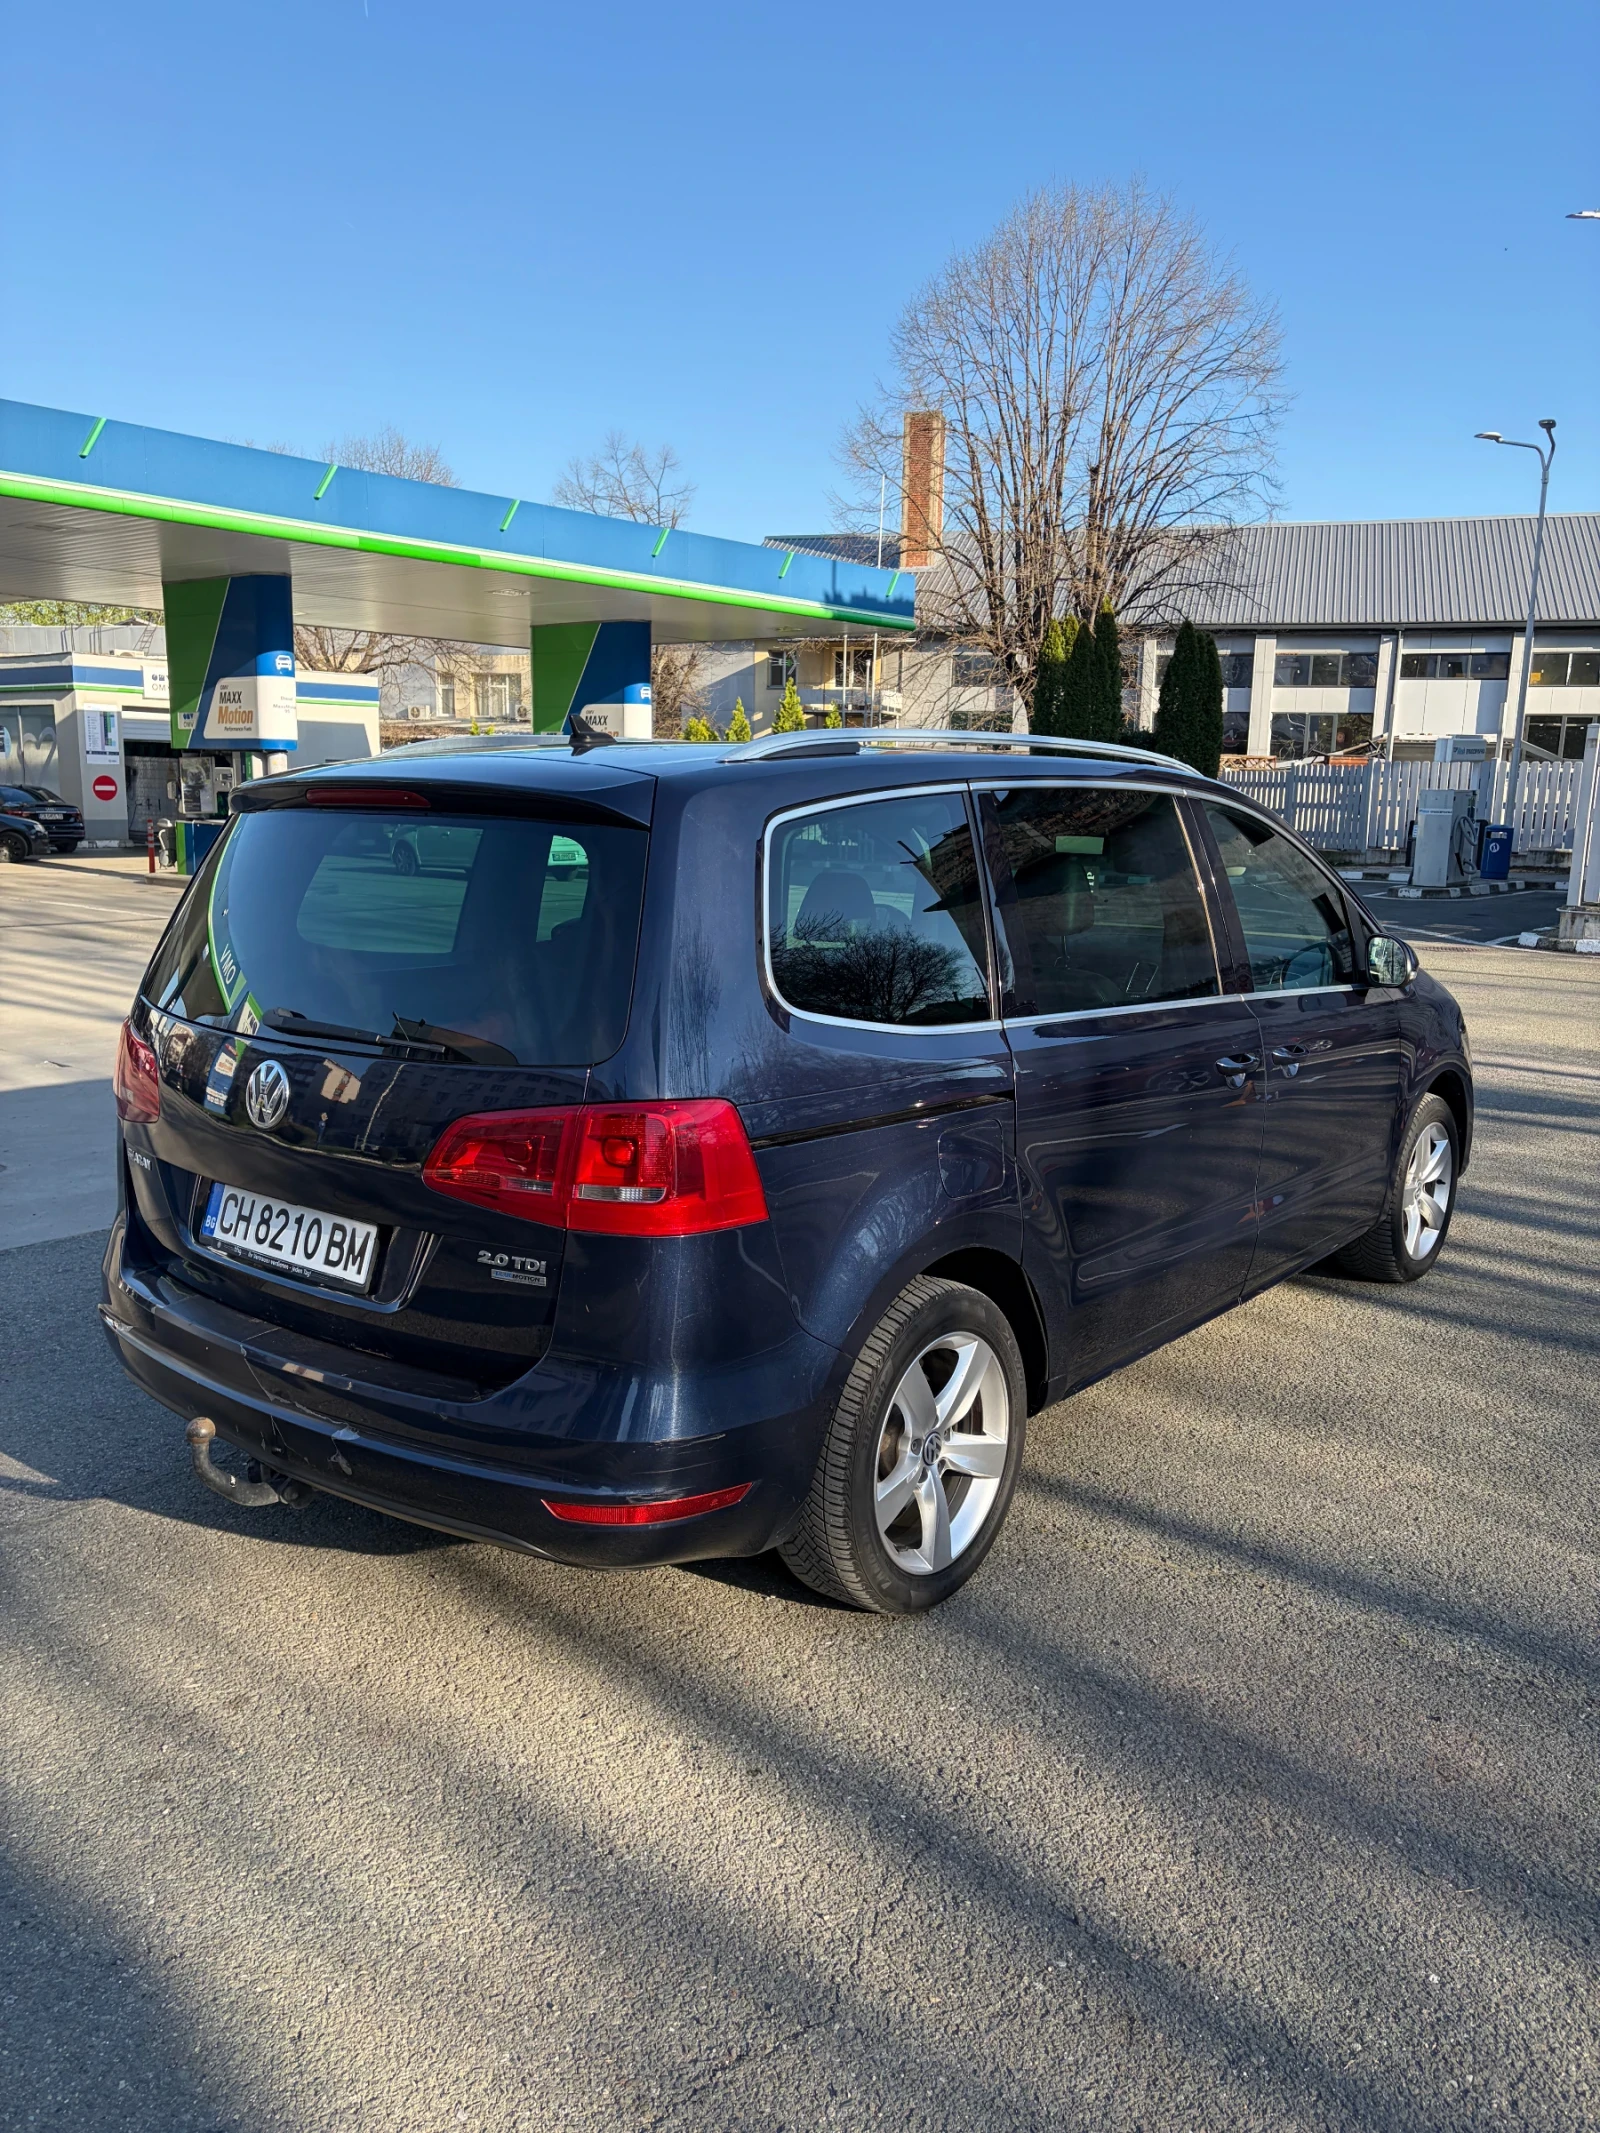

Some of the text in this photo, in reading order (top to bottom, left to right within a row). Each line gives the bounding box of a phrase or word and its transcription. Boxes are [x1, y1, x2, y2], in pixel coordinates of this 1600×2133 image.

[219, 691, 242, 704] MAXX
[217, 706, 254, 724] Motion
[585, 715, 608, 726] MAXX
[205, 1214, 216, 1229] BG
[219, 1192, 371, 1275] CH 8210 BM
[477, 1250, 547, 1274] 2.0 TDI
